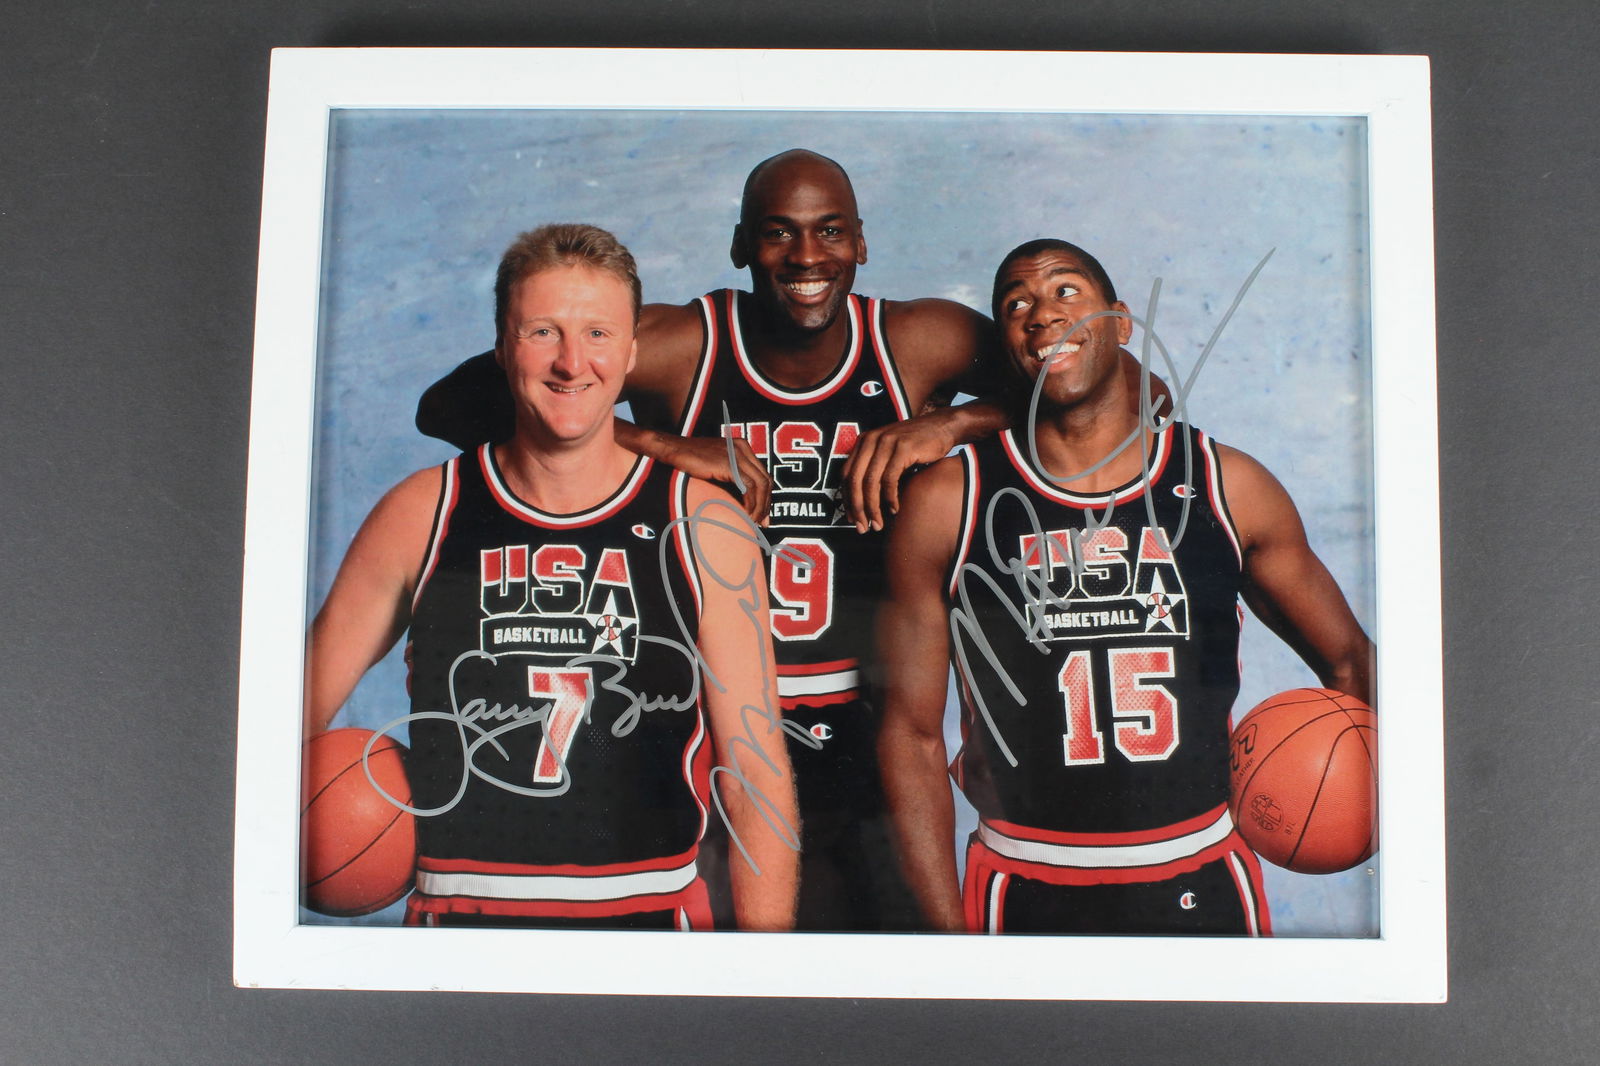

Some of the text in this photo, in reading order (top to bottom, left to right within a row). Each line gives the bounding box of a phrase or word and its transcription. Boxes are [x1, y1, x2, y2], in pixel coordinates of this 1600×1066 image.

[480, 544, 639, 618] USA
[769, 537, 834, 642] 9
[1019, 526, 1188, 601] USA
[493, 627, 587, 645] BASKETBALL
[527, 665, 595, 783] 7
[1057, 646, 1180, 766] 15
